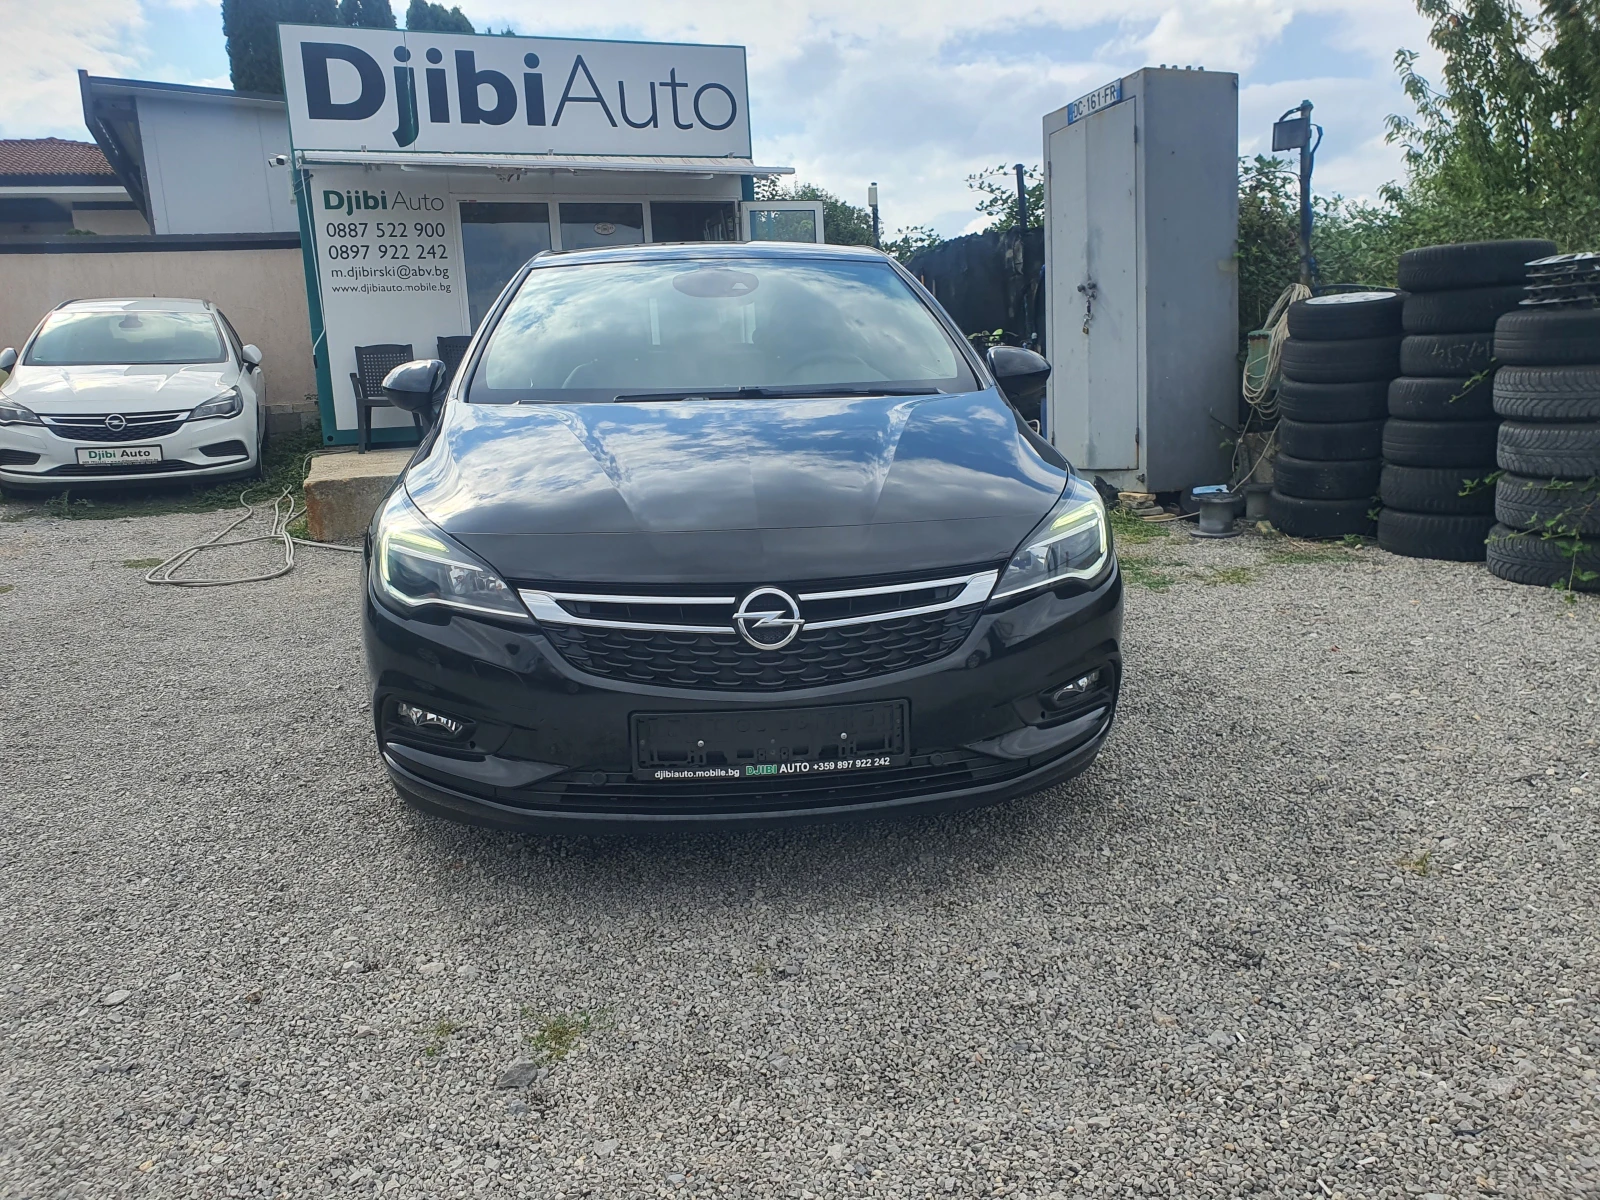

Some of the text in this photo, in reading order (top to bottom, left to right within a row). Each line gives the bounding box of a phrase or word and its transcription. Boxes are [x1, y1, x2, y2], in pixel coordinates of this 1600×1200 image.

[1073, 84, 1116, 119] DC-161-FR
[322, 190, 444, 216] Djibi Auto
[326, 222, 445, 238] 0887 522 900
[328, 244, 448, 260] 0897 922 242
[331, 264, 450, 280] m.djibirski@abv.bg
[331, 282, 452, 295] www.djibiauto.mobile.bg
[88, 450, 151, 460] Djibi Auto
[654, 757, 890, 780] djibiauto.mobile.bg DJIBI AUTO +359 897 922 242
